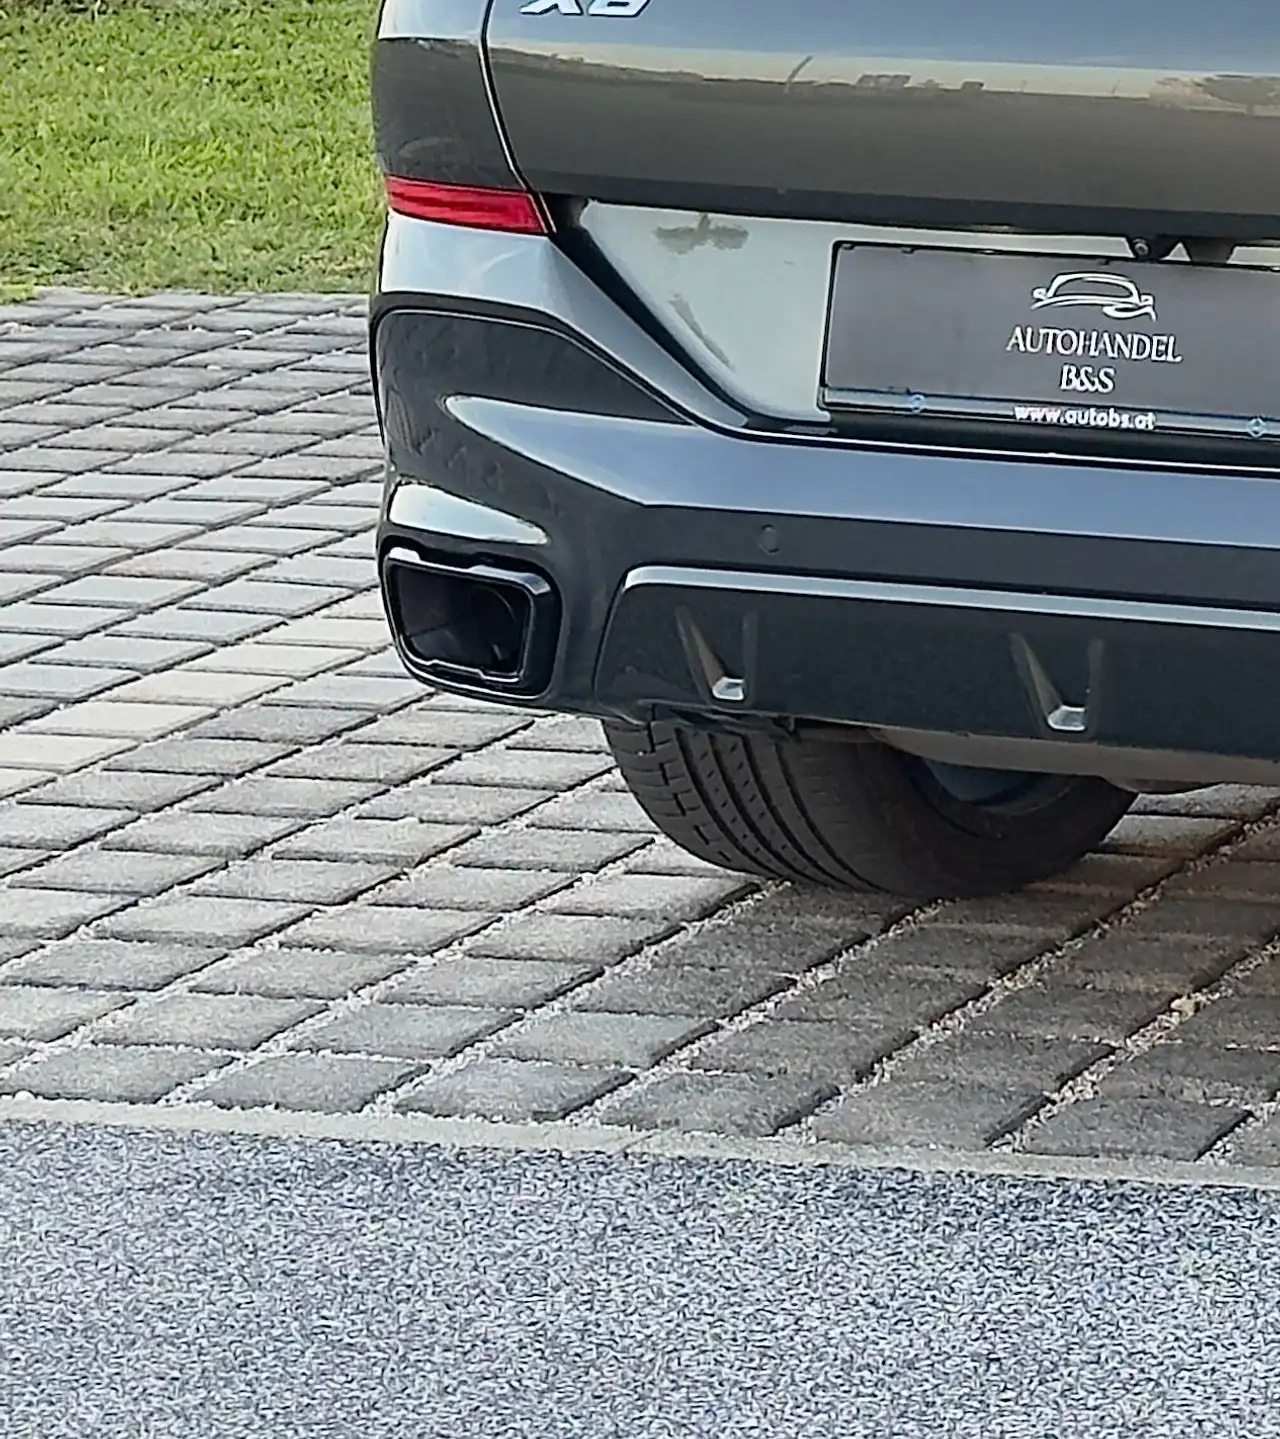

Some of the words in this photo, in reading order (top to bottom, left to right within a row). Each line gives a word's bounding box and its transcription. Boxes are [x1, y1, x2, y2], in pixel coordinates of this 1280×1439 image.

[1005, 325, 1183, 363] AUTOHANDEL
[1059, 363, 1117, 394] B&S
[1013, 405, 1157, 431] www.autobs.at
